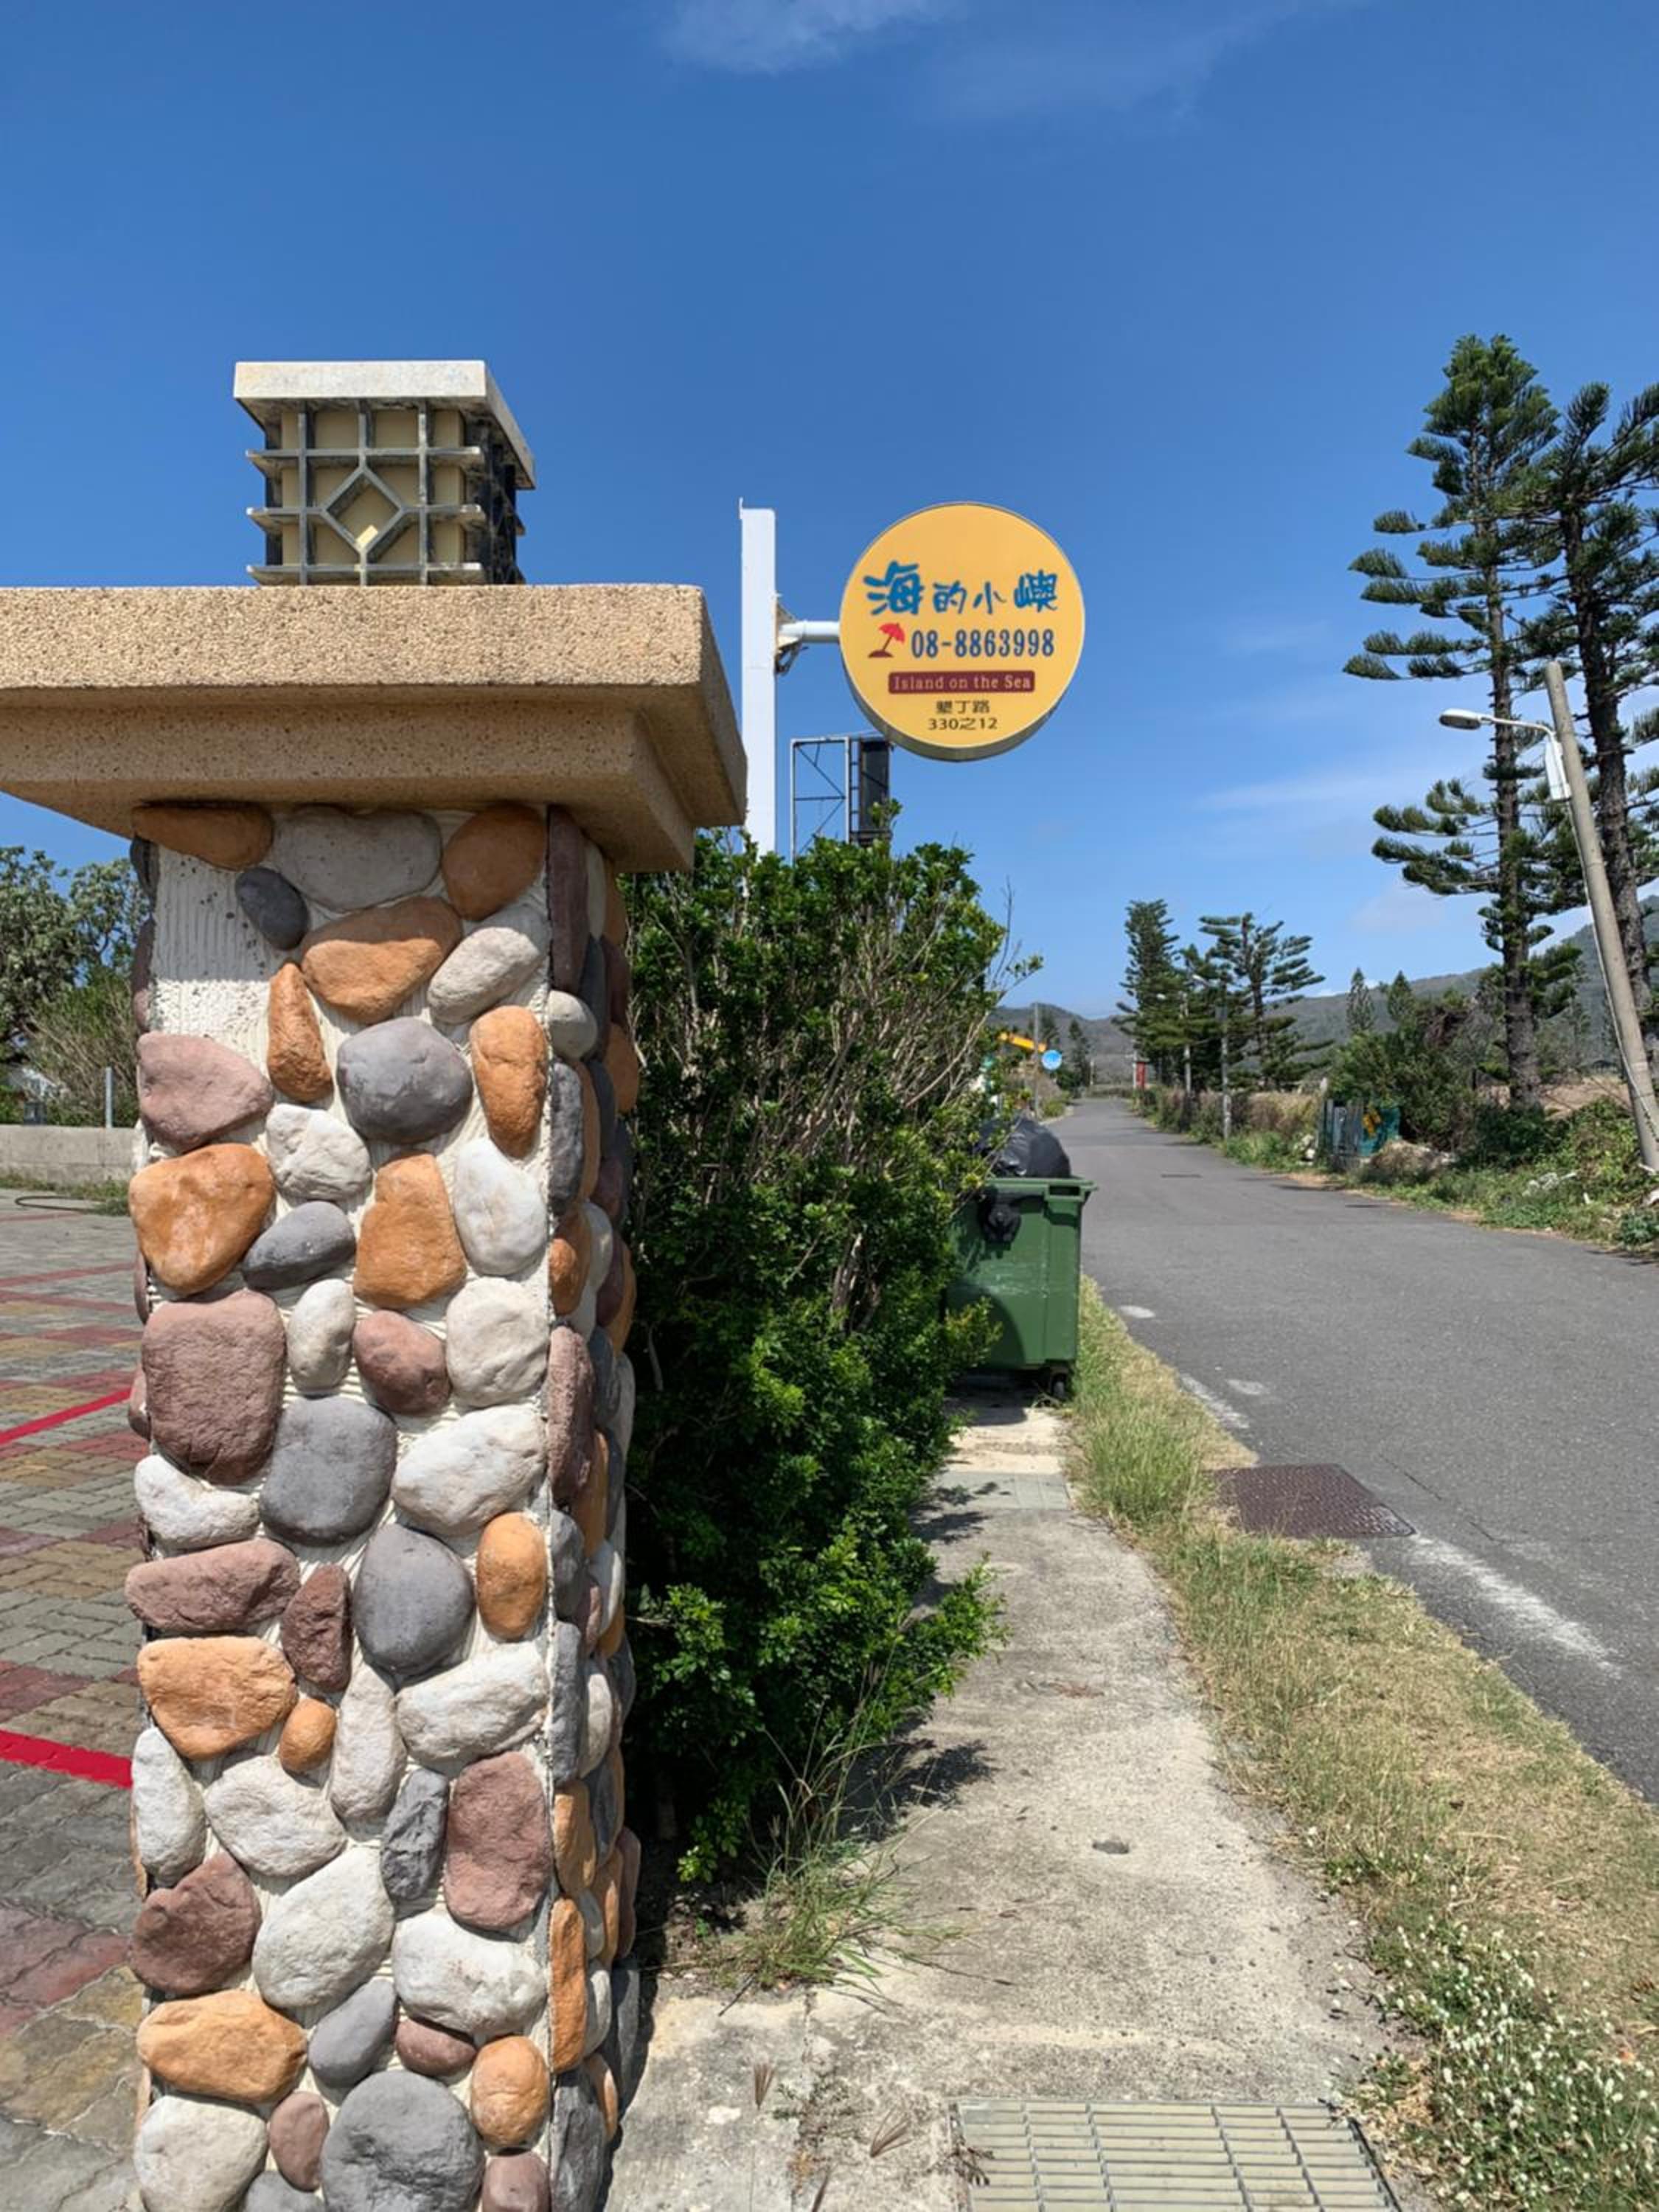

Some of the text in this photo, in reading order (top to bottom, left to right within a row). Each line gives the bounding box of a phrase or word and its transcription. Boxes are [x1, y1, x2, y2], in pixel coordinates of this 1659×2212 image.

[863, 561, 1057, 615] 海的小嶼
[911, 629, 1054, 658] 08-8863998
[894, 674, 1031, 690] Island on the Sea
[936, 700, 990, 714] 墾丁路
[928, 717, 998, 731] 330之12
